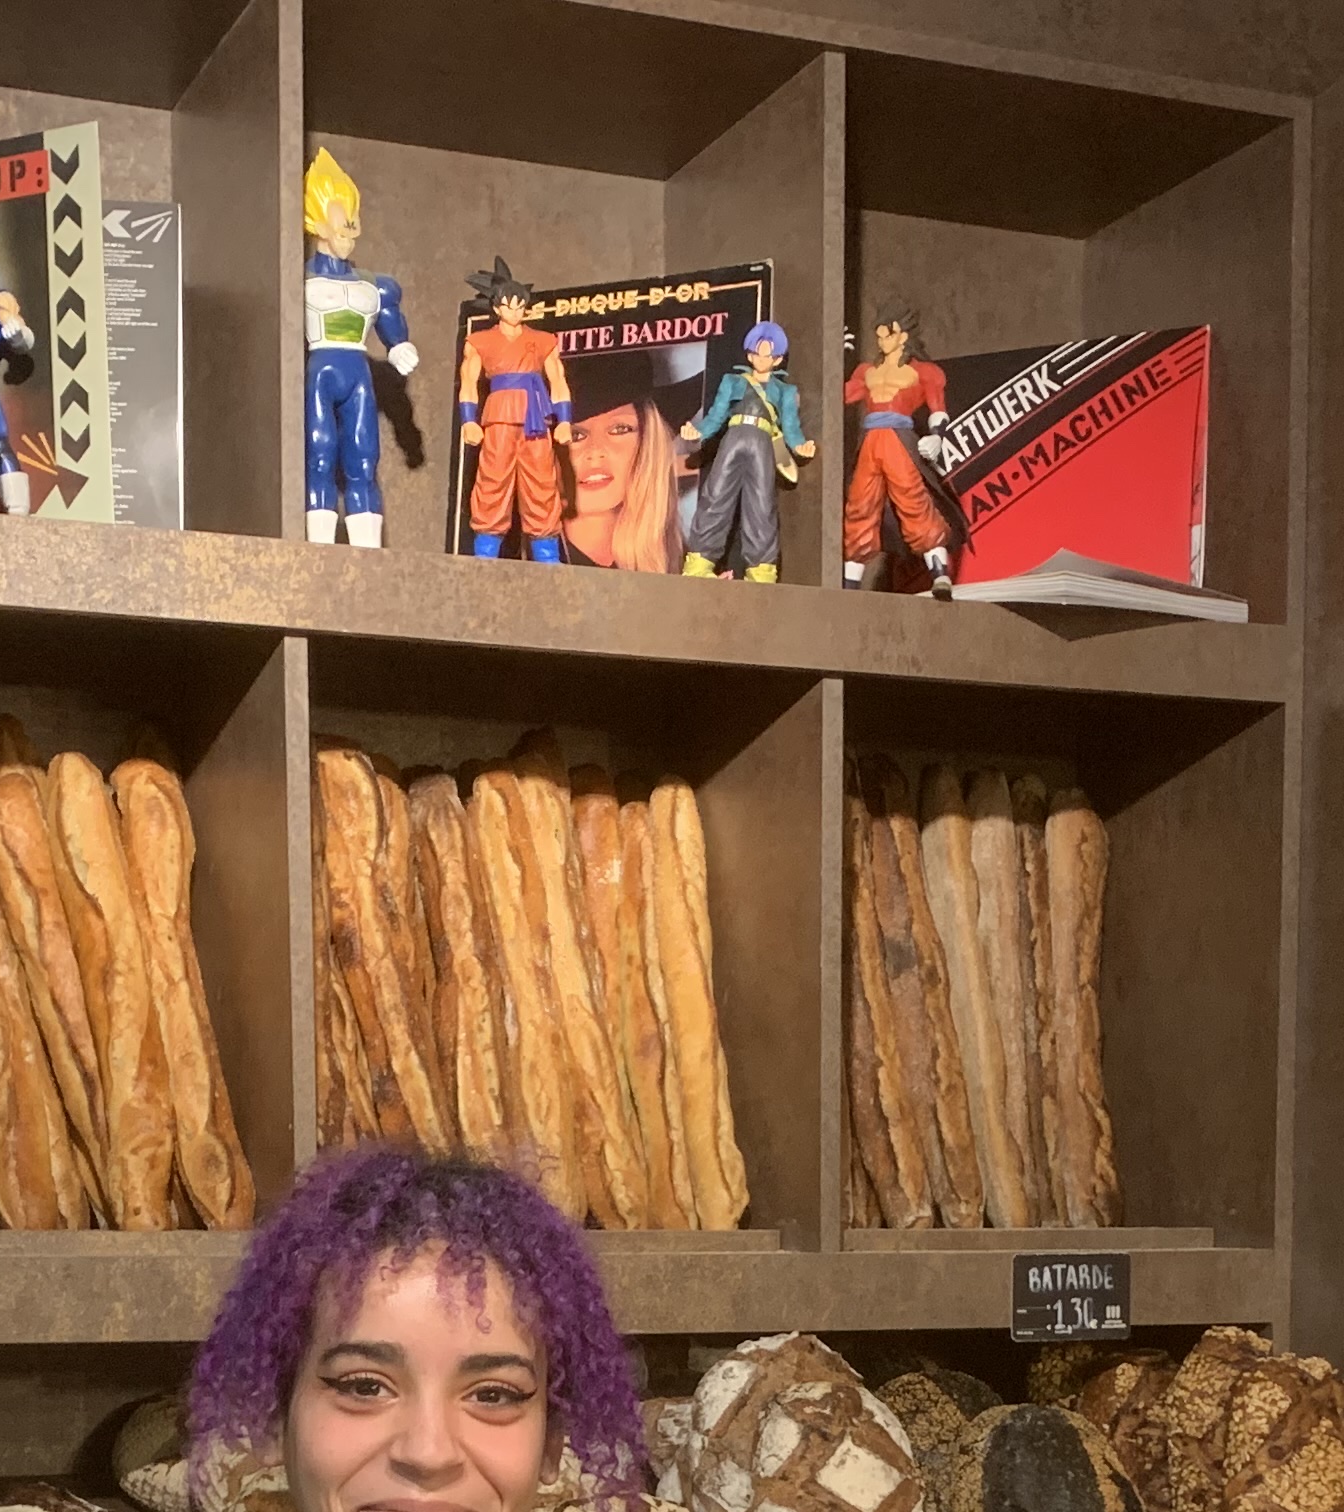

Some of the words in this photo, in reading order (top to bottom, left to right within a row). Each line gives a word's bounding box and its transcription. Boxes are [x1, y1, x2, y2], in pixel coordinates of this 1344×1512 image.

[554, 289, 639, 317] DISQUE
[621, 311, 729, 346] BARDOT
[932, 363, 1062, 476] AFTWERK
[1027, 1264, 1115, 1293] BATARDE
